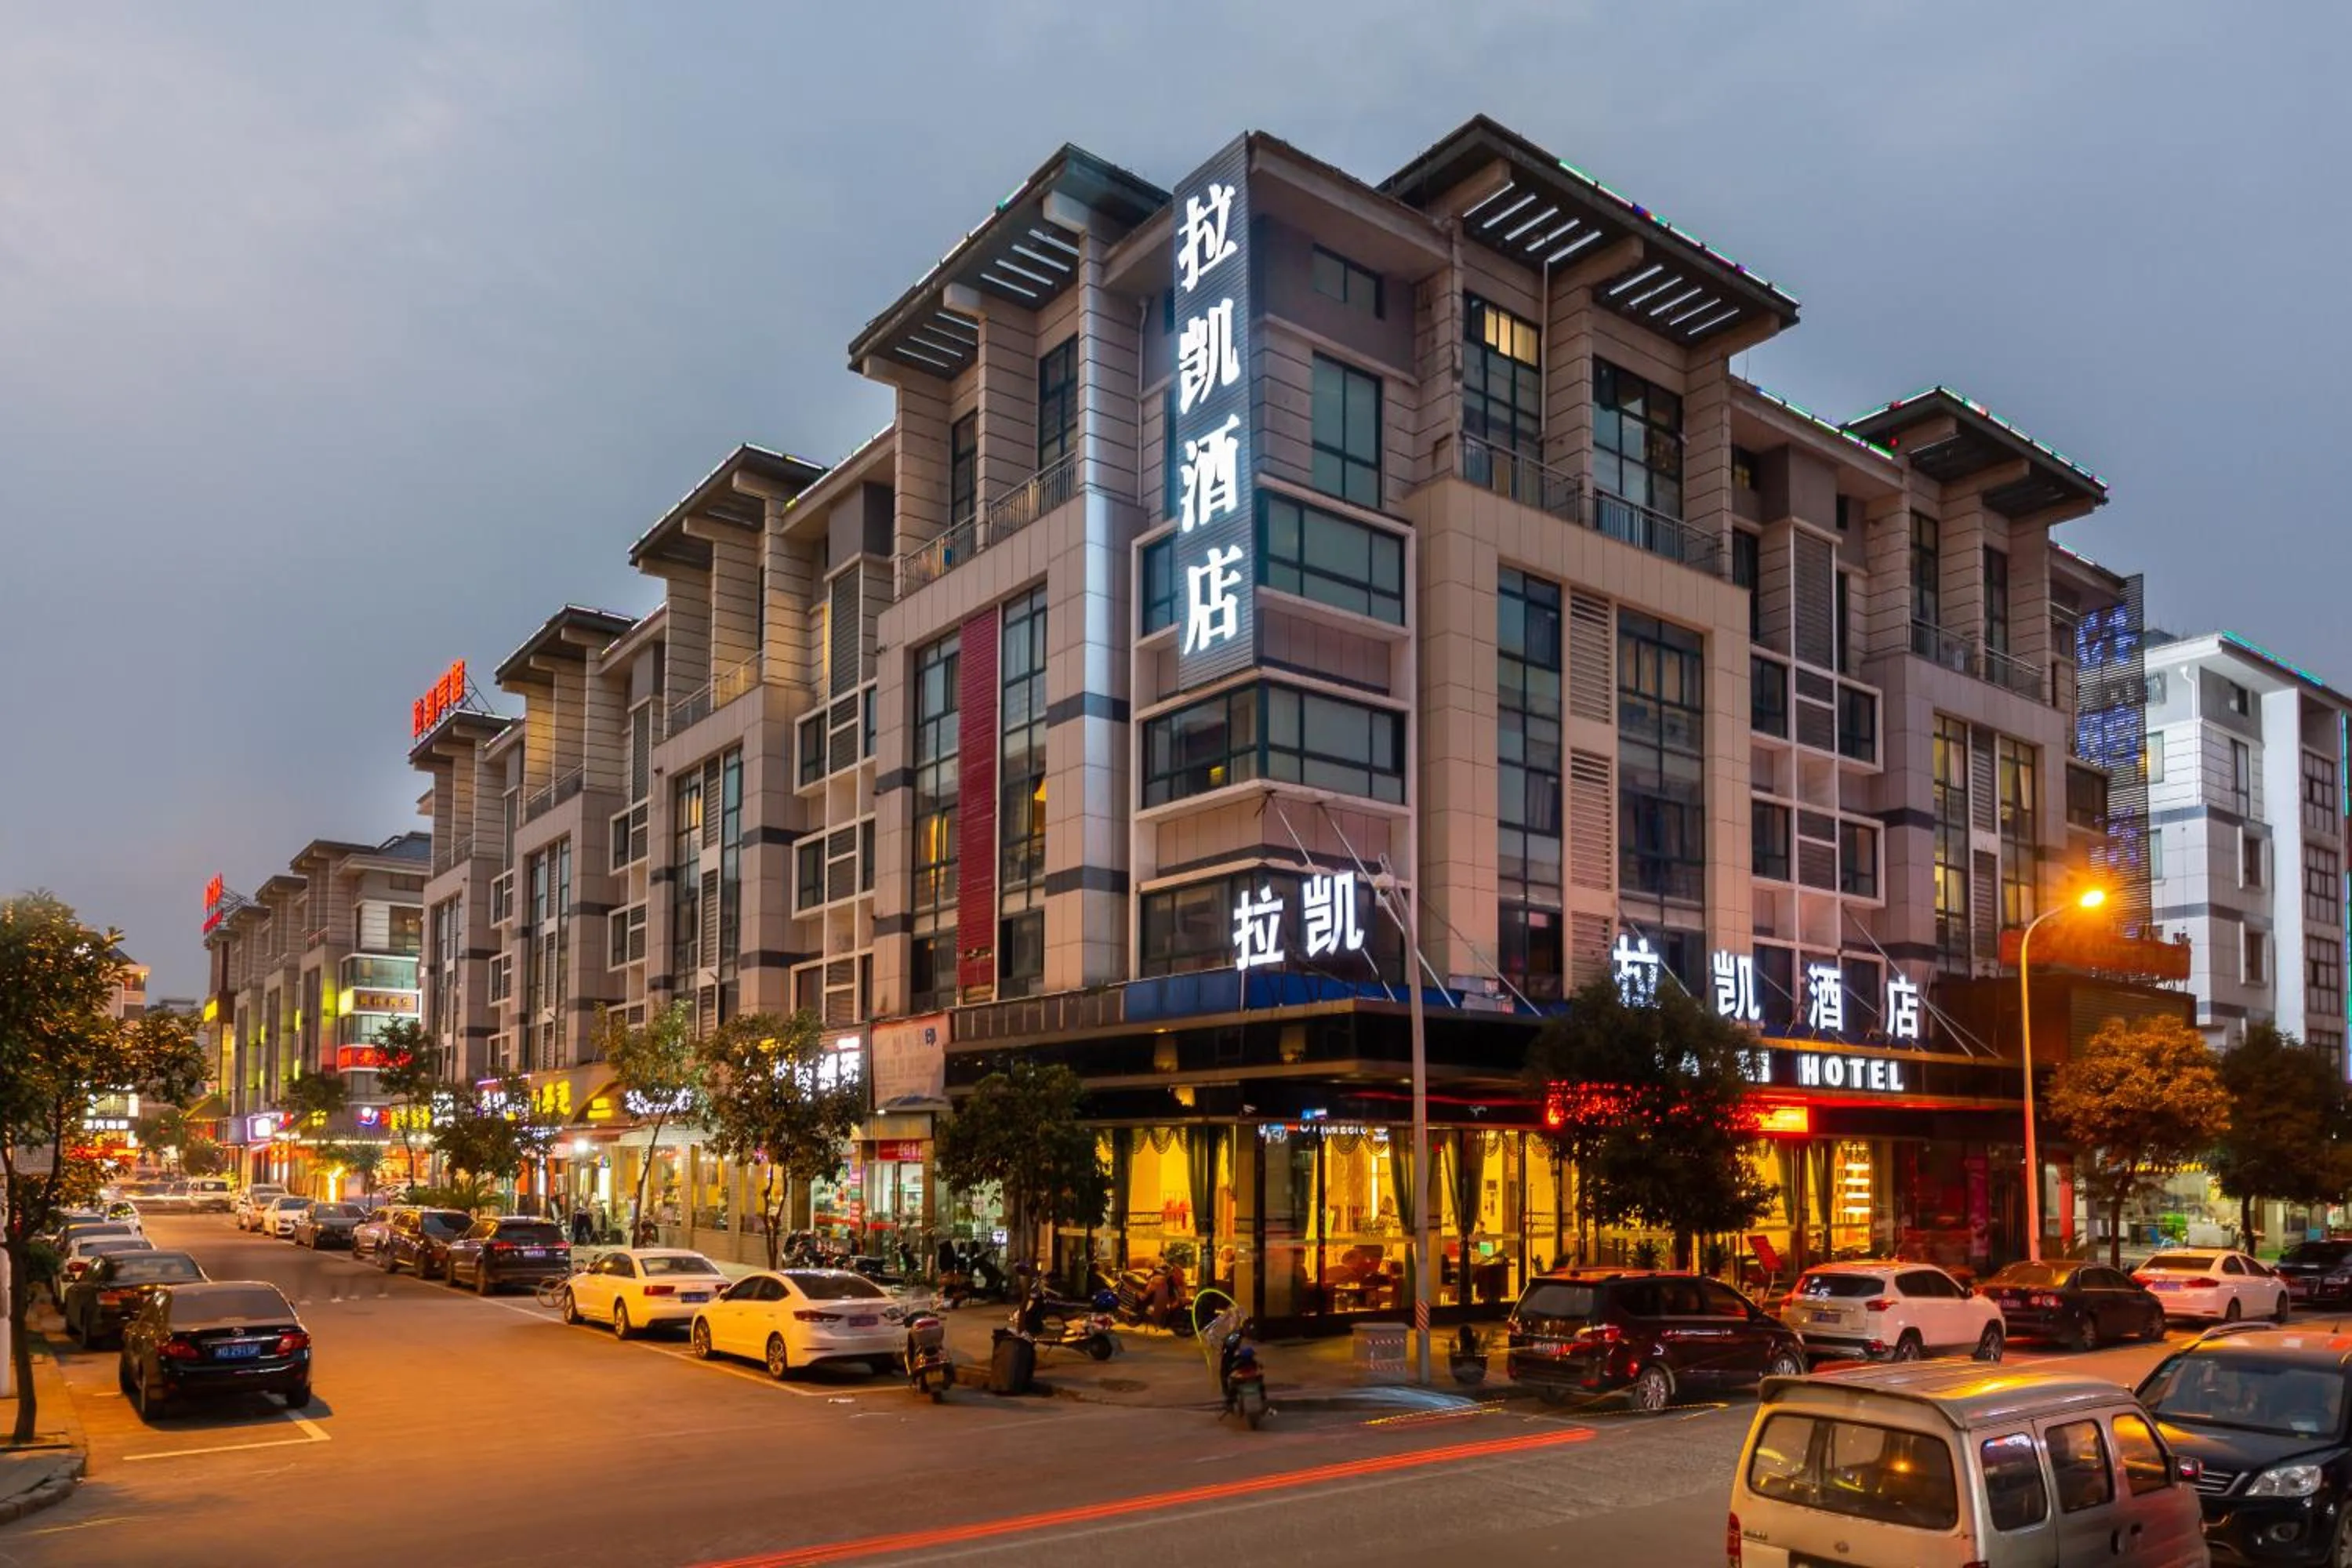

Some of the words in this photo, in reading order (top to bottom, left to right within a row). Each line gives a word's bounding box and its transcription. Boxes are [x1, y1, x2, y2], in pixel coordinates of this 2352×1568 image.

[1178, 183, 1243, 655] 拉凯酒店
[1233, 871, 1364, 971] 拉凯
[1613, 934, 1919, 1039] 拉凯酒店
[1798, 1054, 1904, 1091] HOTEL
